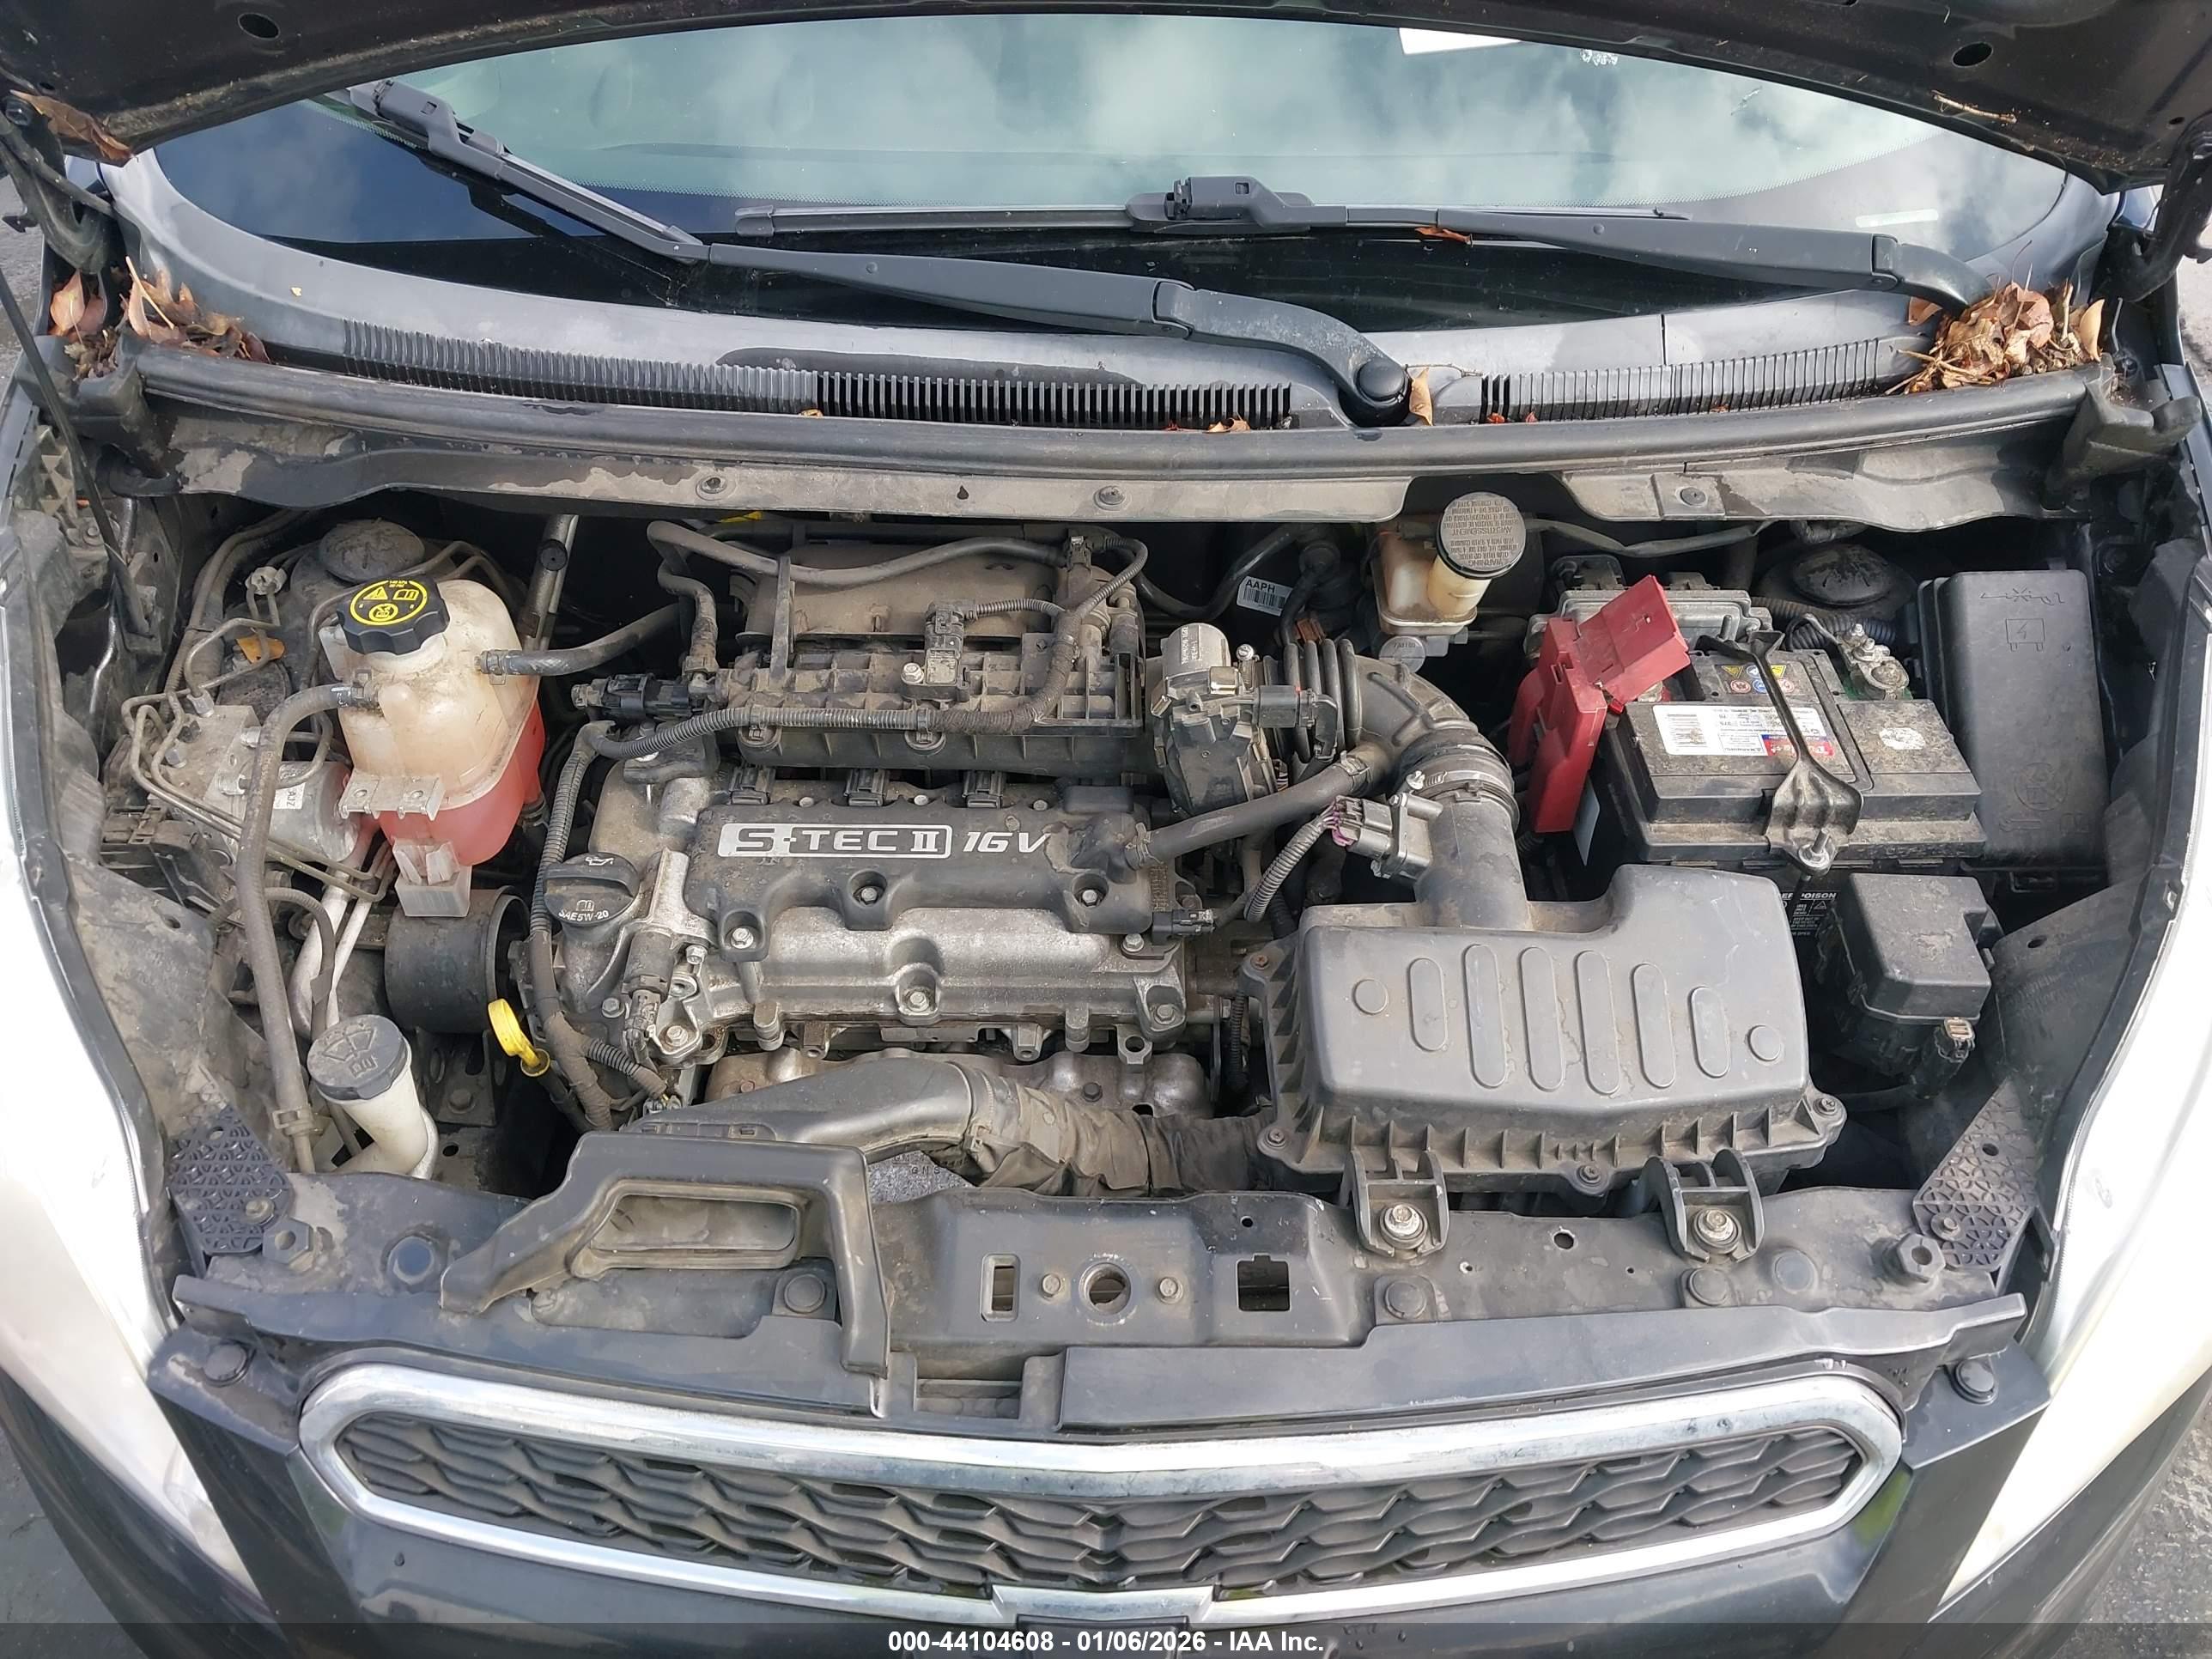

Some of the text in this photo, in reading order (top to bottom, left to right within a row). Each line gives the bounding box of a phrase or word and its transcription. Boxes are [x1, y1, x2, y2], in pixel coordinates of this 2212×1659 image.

[1245, 579, 1276, 593] AAPH
[736, 827, 1051, 854] S-TEC II 16V
